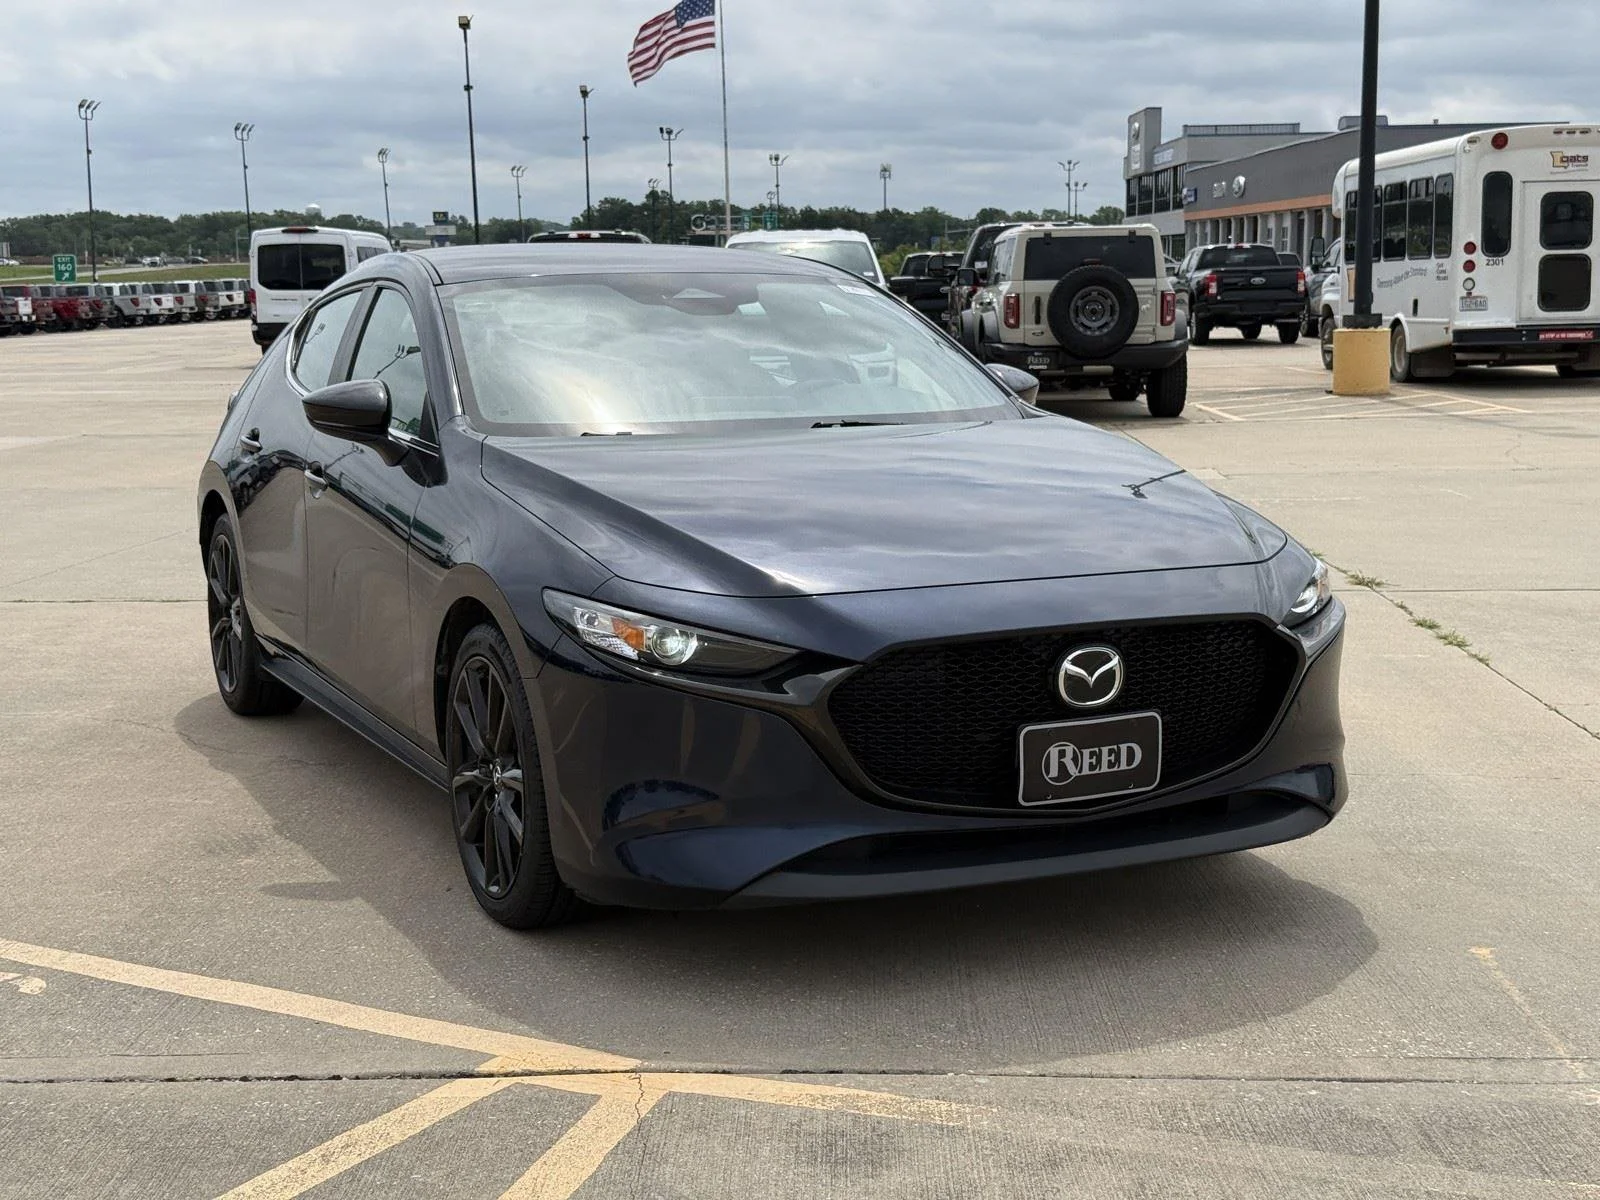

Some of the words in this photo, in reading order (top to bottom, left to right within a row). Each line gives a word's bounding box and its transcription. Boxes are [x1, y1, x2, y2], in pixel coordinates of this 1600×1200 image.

[1485, 258, 1504, 266] 2301
[57, 263, 73, 271] 160
[1045, 742, 1143, 779] REED
